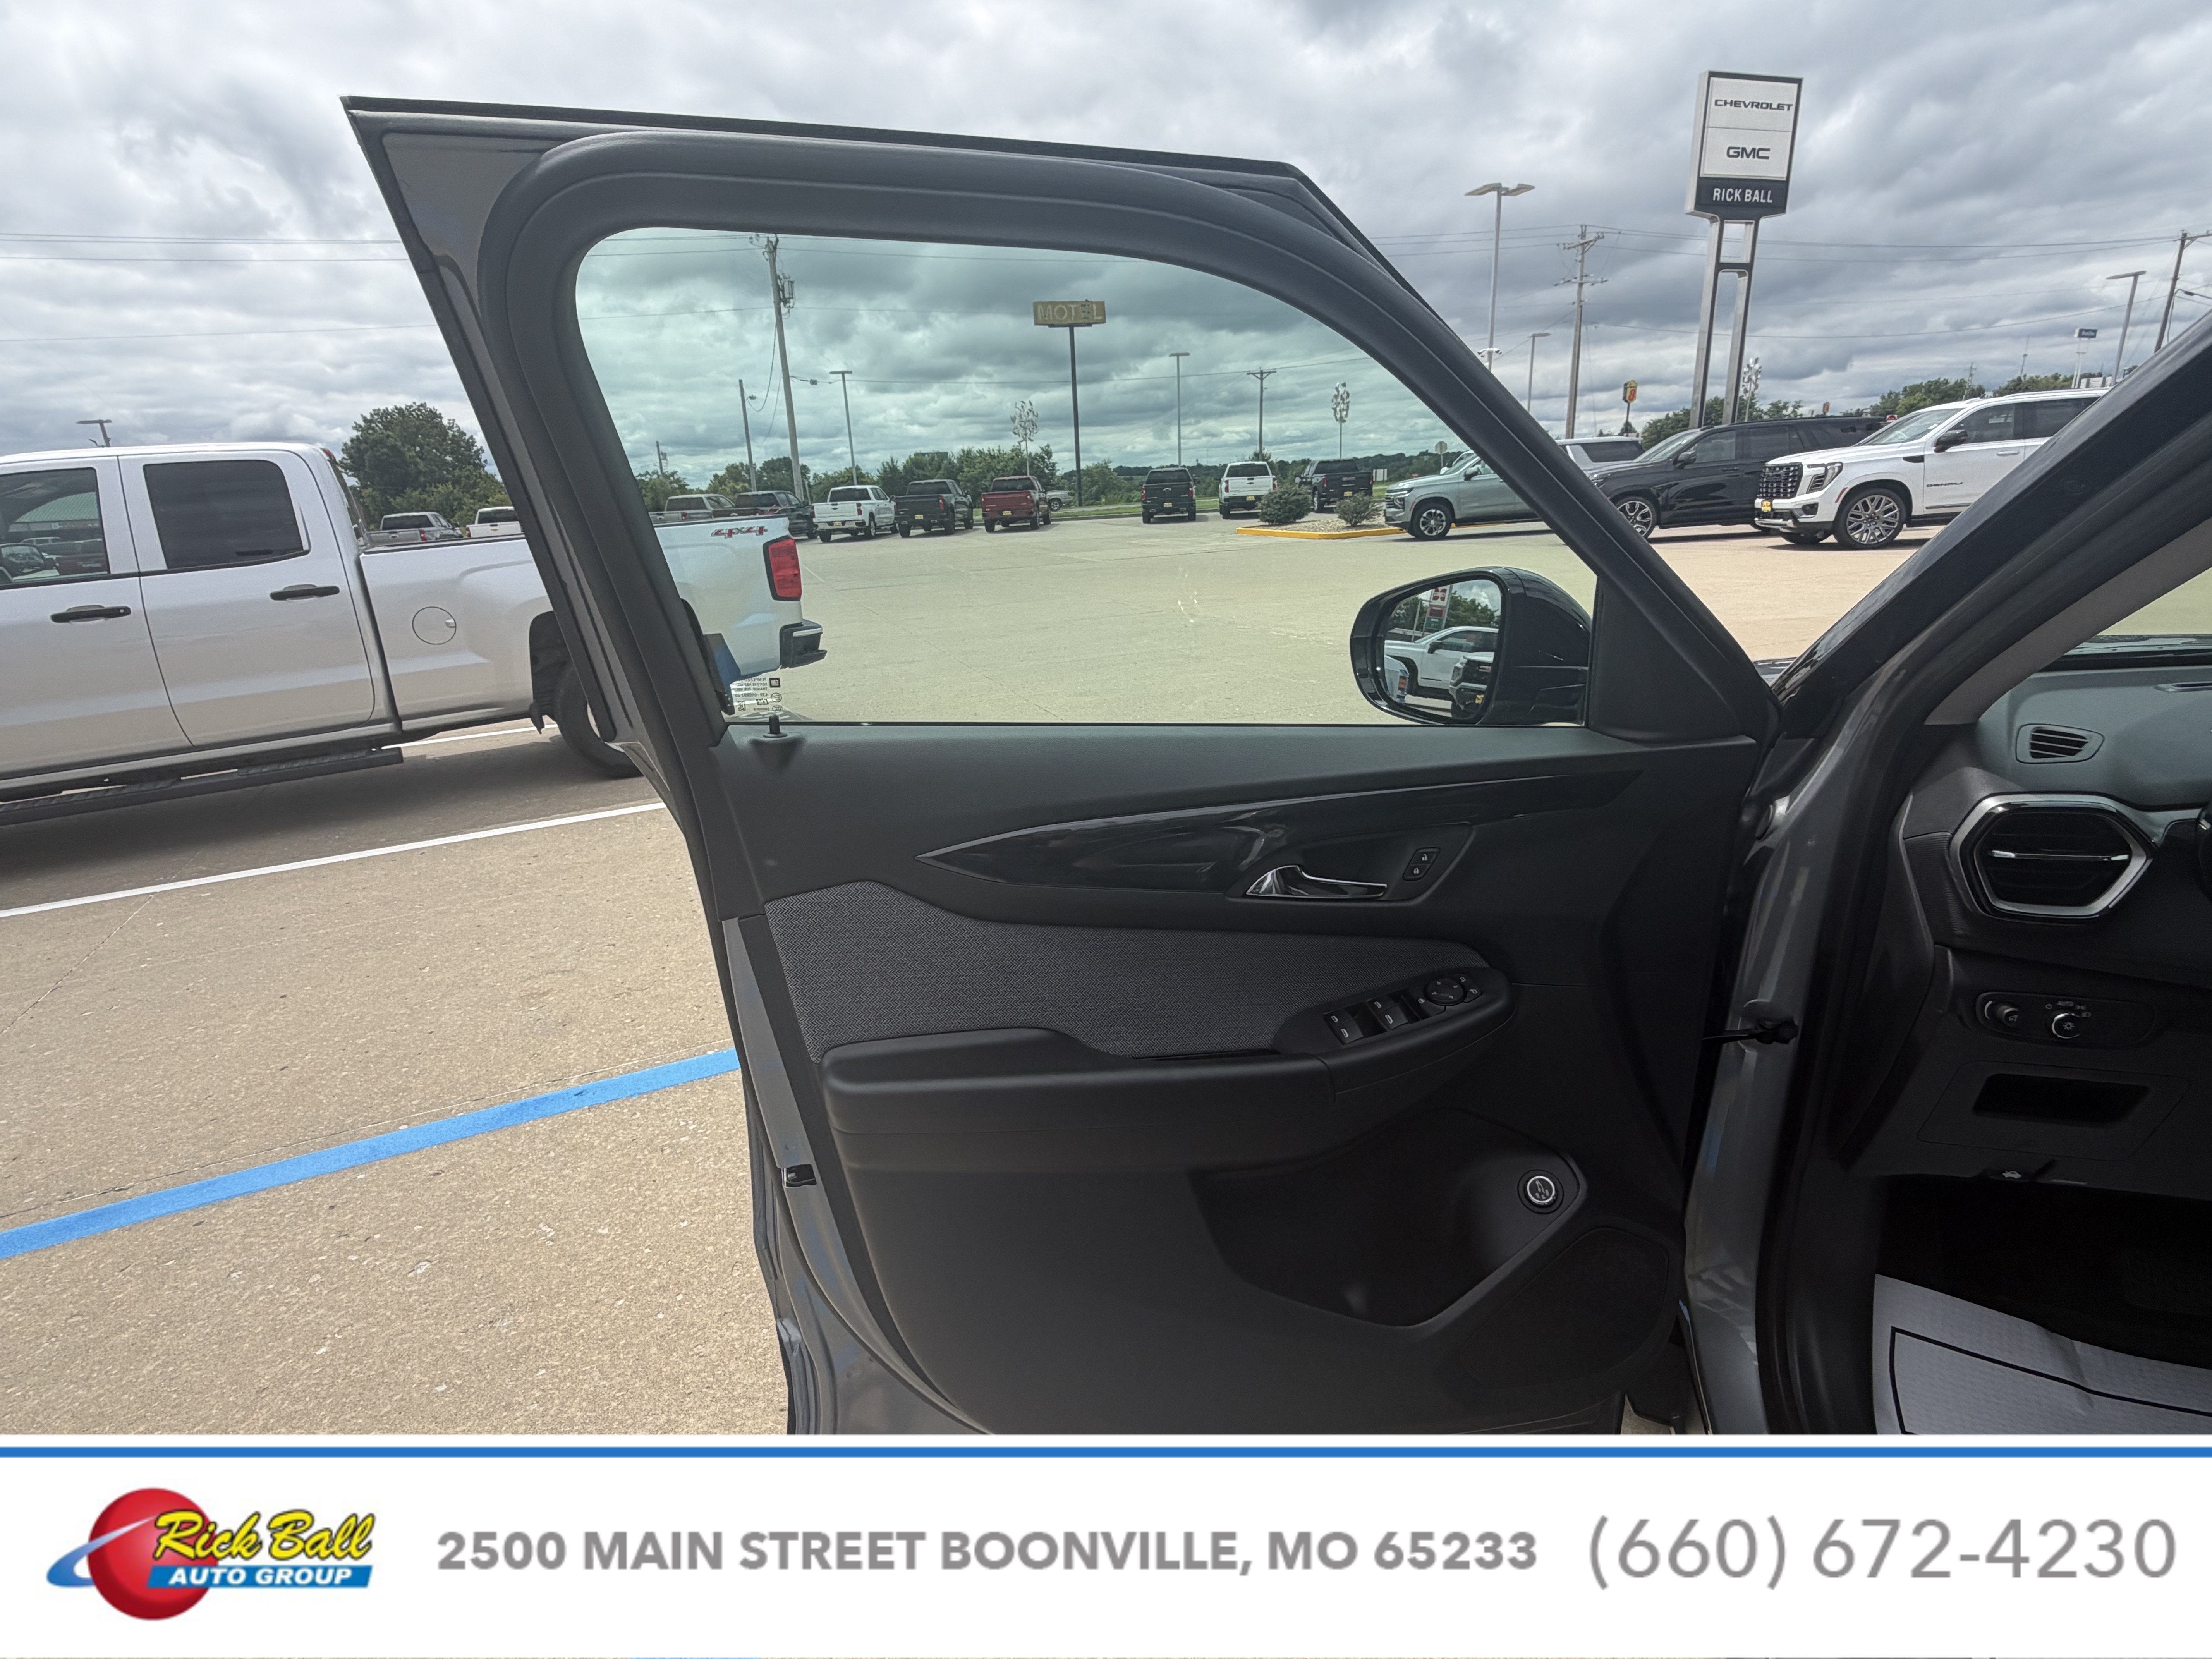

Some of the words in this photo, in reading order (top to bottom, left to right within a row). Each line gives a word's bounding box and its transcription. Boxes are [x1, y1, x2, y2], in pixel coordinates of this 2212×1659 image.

[1714, 99, 1793, 111] CHEVROLET
[1726, 146, 1771, 160] GMC
[1712, 187, 1742, 202] RICK
[1744, 189, 1773, 203] BALL
